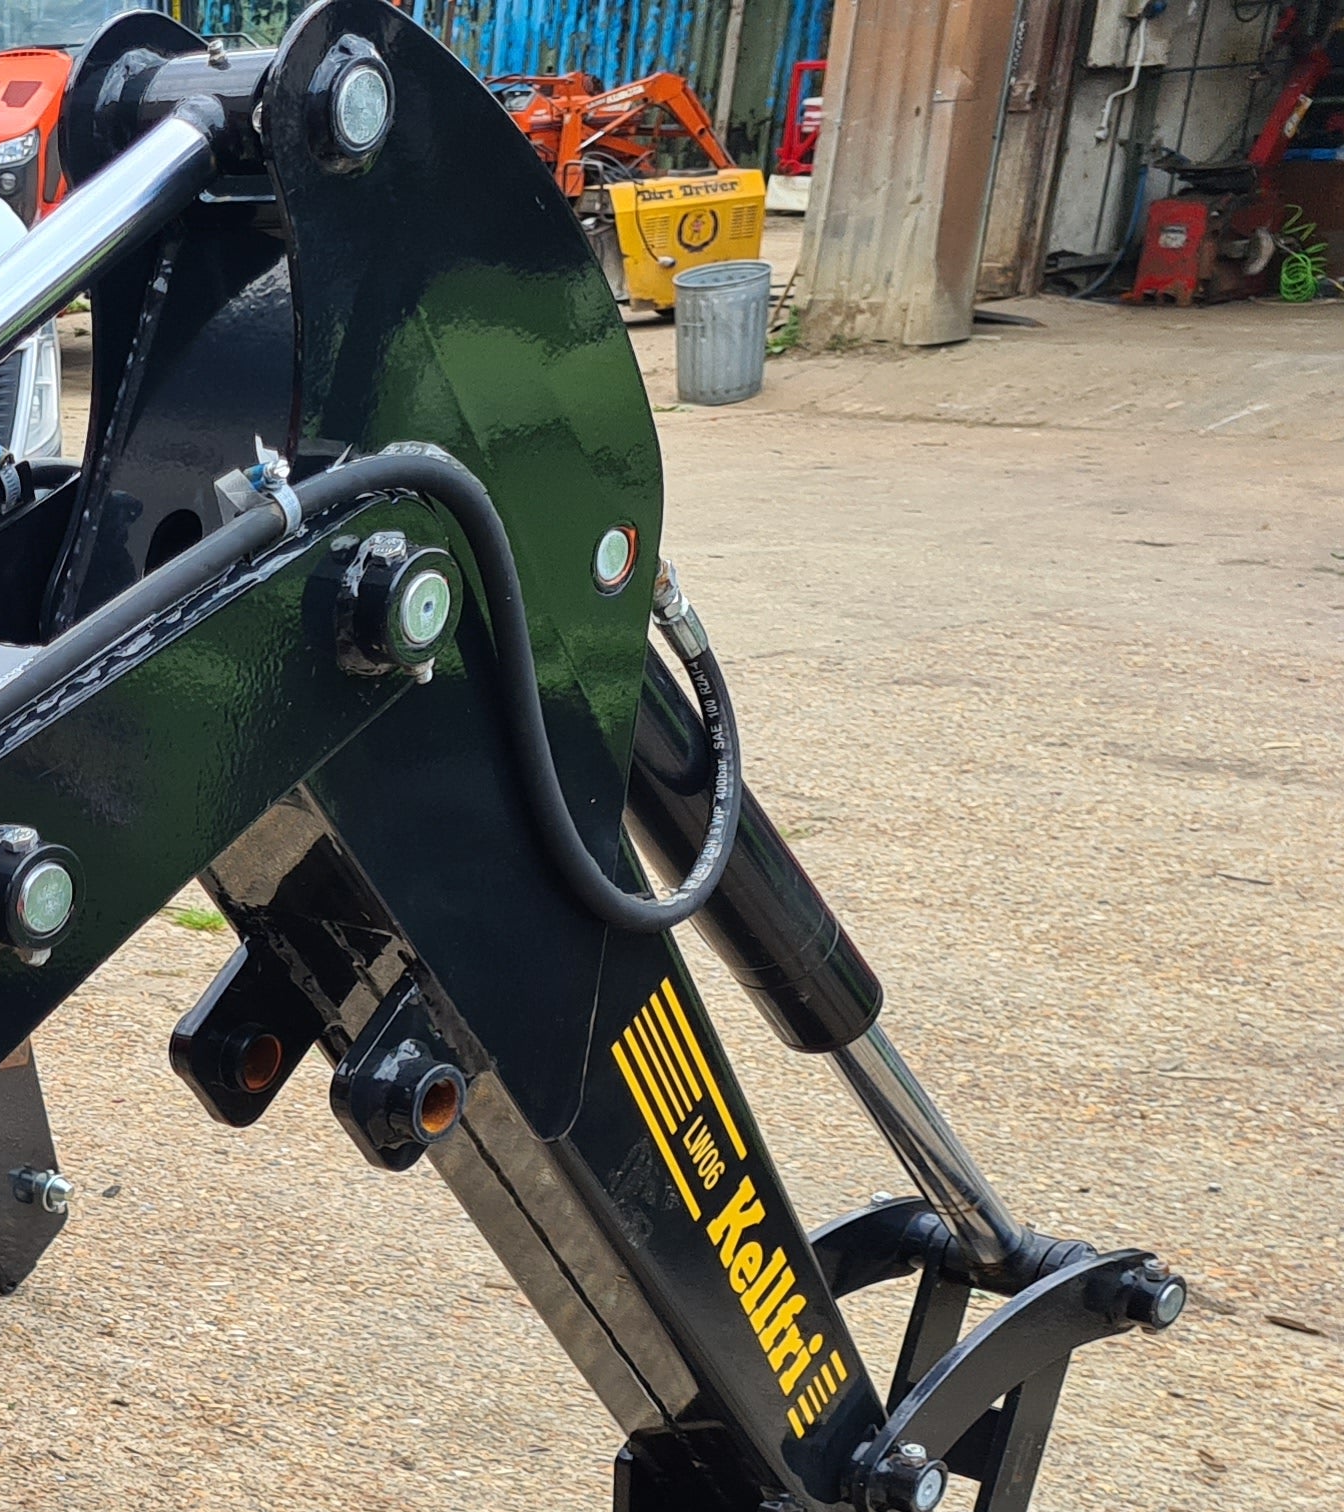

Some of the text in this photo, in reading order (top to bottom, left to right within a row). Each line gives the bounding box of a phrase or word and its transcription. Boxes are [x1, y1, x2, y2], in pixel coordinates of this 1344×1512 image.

[679, 180, 740, 199] Driver
[704, 698, 721, 721] 100
[710, 723, 726, 750] SAE
[682, 1115, 726, 1191] LW06
[705, 1173, 825, 1398] Kellfri
